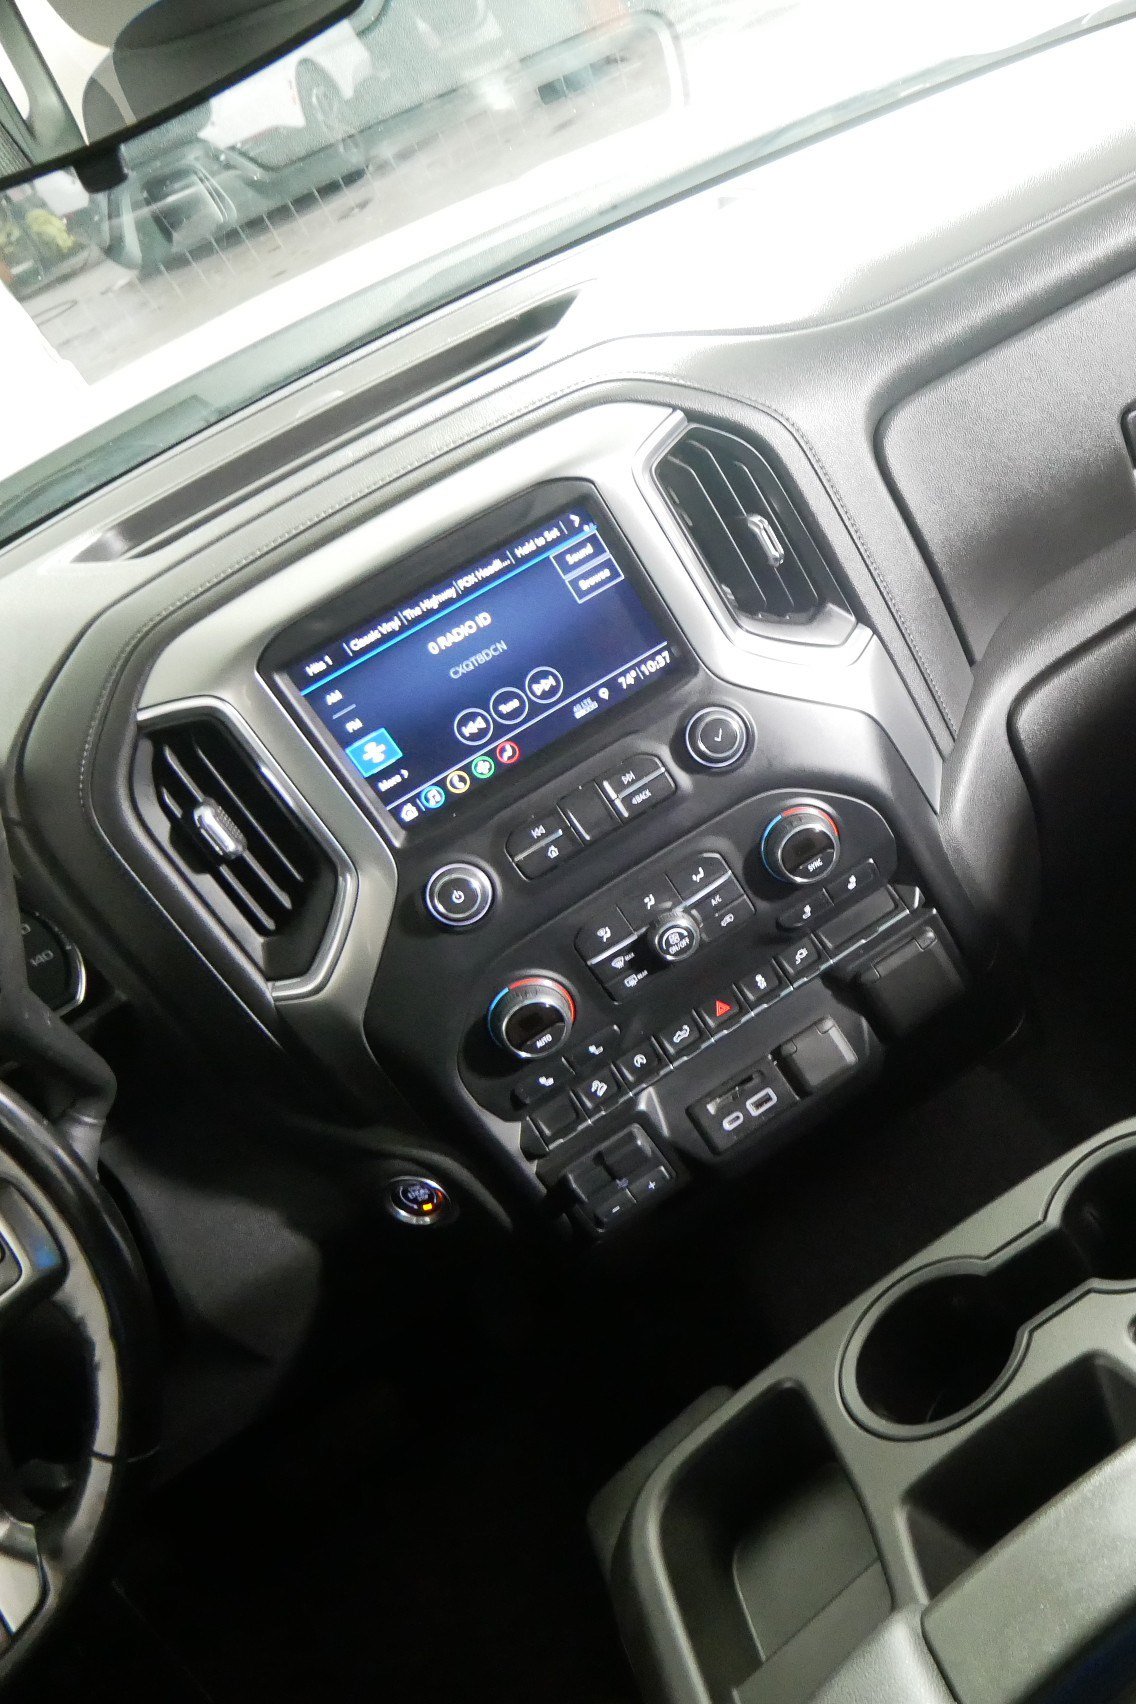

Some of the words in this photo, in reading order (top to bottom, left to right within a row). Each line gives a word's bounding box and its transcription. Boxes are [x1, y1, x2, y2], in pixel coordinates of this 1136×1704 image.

[535, 536, 545, 546] to
[544, 527, 560, 542] Set
[565, 542, 594, 565] Sound
[457, 572, 479, 590] FOX
[579, 568, 611, 590] Browse
[403, 607, 422, 620] The
[420, 587, 457, 609] Highway
[350, 630, 381, 651] Classic
[378, 616, 401, 634] Vinyl
[437, 620, 478, 650] RADIO
[475, 611, 492, 628] ID
[306, 661, 326, 676] Hits
[324, 655, 333, 666] 1
[449, 640, 508, 679] CXQT8DCN
[326, 689, 343, 706] AM
[498, 699, 520, 714] Tune
[346, 718, 363, 733] FM
[378, 773, 402, 792] More
[635, 788, 652, 803] BACK
[807, 858, 823, 872] SYNC
[711, 894, 722, 907] A/C
[668, 937, 690, 955] ON/OFF
[536, 1033, 552, 1049] AUTO
